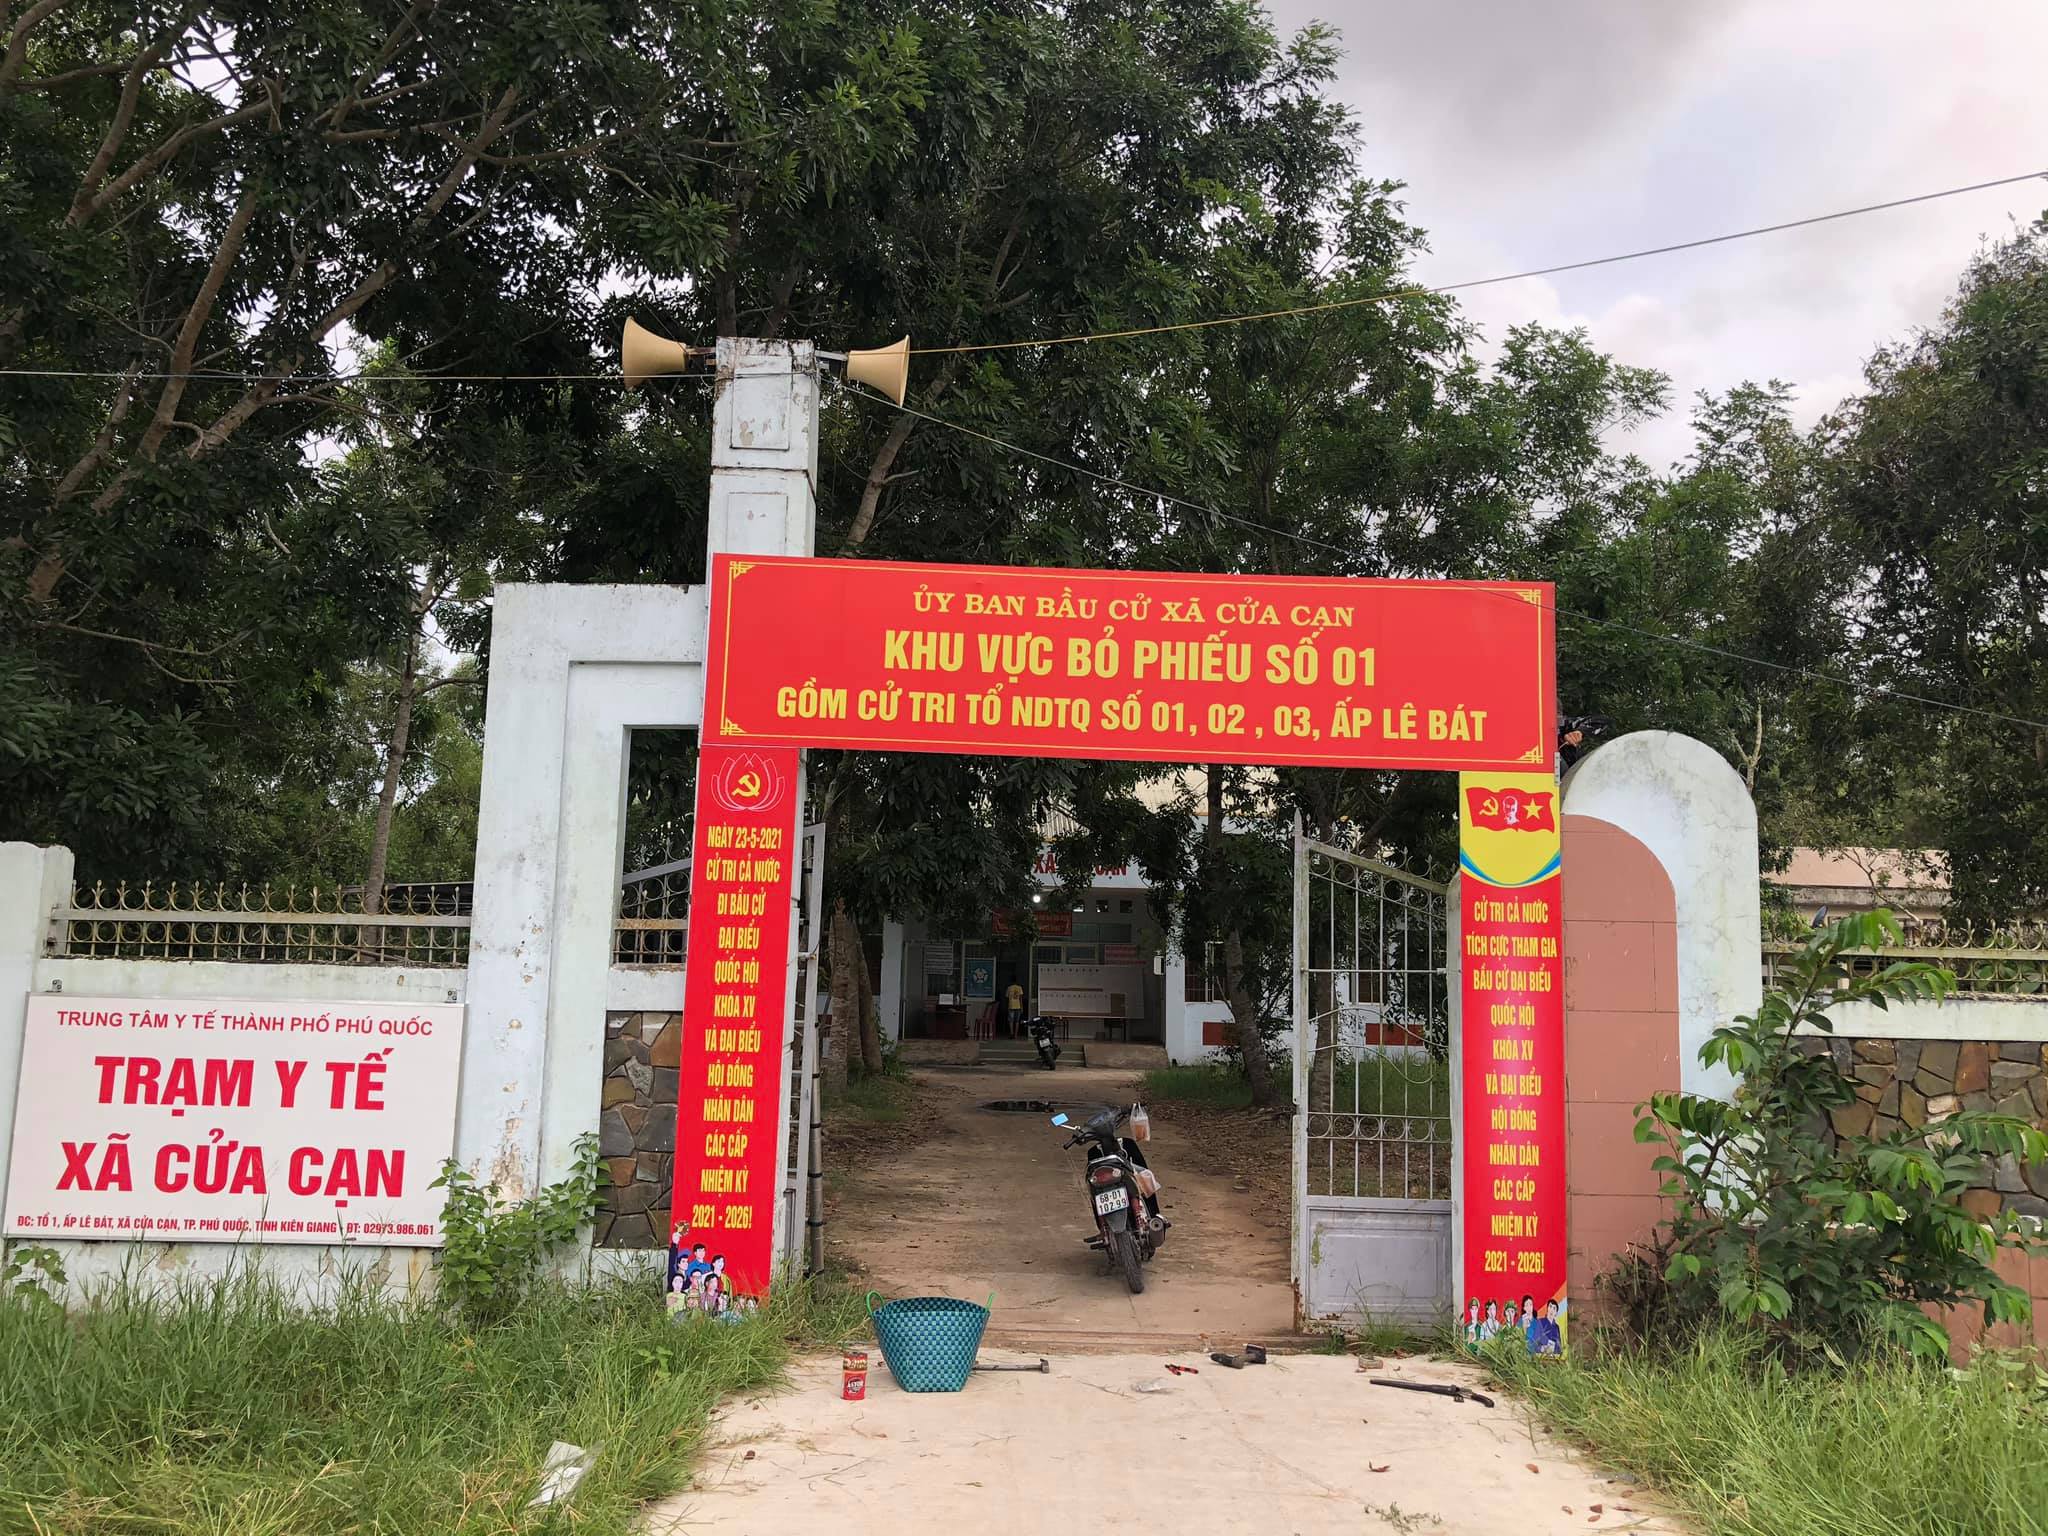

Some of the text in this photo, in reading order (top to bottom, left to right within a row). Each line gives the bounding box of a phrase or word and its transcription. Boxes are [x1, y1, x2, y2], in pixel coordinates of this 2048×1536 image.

[913, 584, 1354, 631] ỦY BAN BẦU CỬ XÃ CỬA CẠN
[884, 625, 1375, 687] KHU VỰC BỎ PHIẾU SỐ 01
[777, 676, 848, 719] GỒM
[857, 680, 903, 721] CỬ
[908, 692, 956, 724] TRI
[965, 682, 1003, 725] TỔ
[1011, 695, 1090, 733] NDTQ
[1101, 690, 1143, 732] SỐ
[1151, 701, 1198, 737] 01,
[1208, 703, 1246, 735] 02
[1273, 705, 1321, 742] 03,
[1330, 696, 1373, 738] ẤP
[1383, 702, 1418, 740] LÊ
[1428, 703, 1488, 742] BÁT
[707, 821, 783, 850] NGÀY 23-5-2021
[706, 852, 781, 882] CỬ TRI CẢ NƯỚC
[717, 892, 729, 915] ĐI
[752, 887, 767, 916] CỬ
[1474, 894, 1549, 924] CỬ TRI CẢ NƯỚC
[718, 918, 760, 954] ĐẠI BIỂU
[1466, 930, 1558, 961] TÍCH CỰC THAM GIA
[714, 953, 760, 989] QUỐC HỘI
[1495, 963, 1510, 991] CỬ
[1510, 971, 1527, 996] ĐẠI
[1528, 963, 1552, 993] BIỂU
[714, 990, 756, 1018] KHÓA XV
[1490, 997, 1536, 1031] QUỐC HỘI
[57, 1009, 434, 1037] TRUNG TÂM Y TẾ THÀNH PHỐ PHÚ QUỐC
[705, 1021, 761, 1057] VÀ ĐẠI BIỂU
[1492, 1034, 1534, 1061] KHÓA XV
[94, 1048, 395, 1117] TRẠM Y TẾ
[707, 1058, 725, 1092] HỘI
[1485, 1066, 1543, 1101] VÀ ĐẠI BIỂU
[703, 1093, 754, 1123] NHÂN DÂN
[1491, 1105, 1508, 1135] HỘI
[705, 1126, 748, 1158] CÁC CẤP
[1489, 1140, 1540, 1167] NHÂN DÂN
[55, 1128, 406, 1208] XÃ CỬA CẠN
[700, 1164, 749, 1198] NHIỆM KỲ
[1493, 1172, 1536, 1201] CÁC CẤP
[17, 1216, 34, 1227] ĐC:
[37, 1212, 50, 1227] TỔ
[53, 1217, 60, 1228] 1,
[63, 1213, 78, 1228] ẤP
[80, 1215, 92, 1228] LÊ
[94, 1215, 114, 1229] BÁT,
[117, 1216, 131, 1229] XÃ
[134, 1214, 154, 1229] CỬA
[157, 1219, 181, 1232] CẠN,
[184, 1219, 197, 1230] TP.
[200, 1218, 220, 1231] PHÚ
[223, 1215, 251, 1232] QUỐC,
[280, 1219, 304, 1232] KIÊN
[306, 1221, 337, 1233] GIANG
[364, 1223, 434, 1235] 02973.986.061
[691, 1204, 715, 1229] 2021
[724, 1205, 753, 1230] 2026!
[1491, 1210, 1539, 1241] NHIỆM KỲ
[1484, 1250, 1508, 1272] 2021
[1517, 1252, 1545, 1273] 2026!
